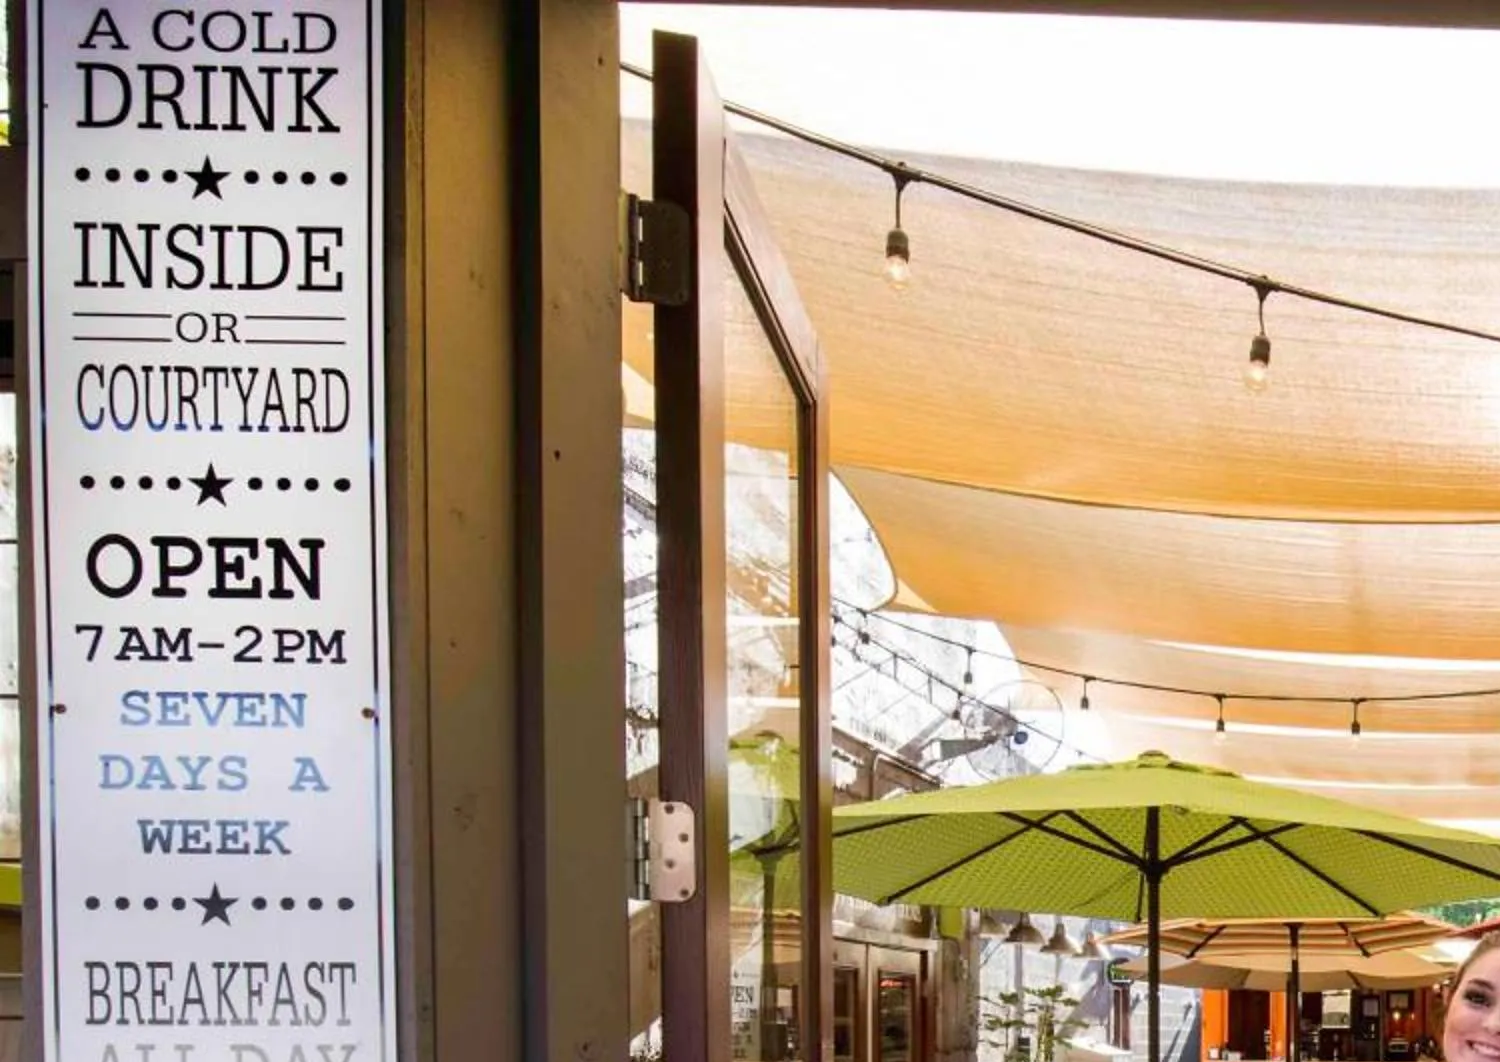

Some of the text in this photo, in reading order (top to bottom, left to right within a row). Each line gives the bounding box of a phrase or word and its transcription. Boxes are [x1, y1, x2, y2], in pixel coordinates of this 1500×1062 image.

[78, 7, 337, 54] A COLD
[74, 60, 341, 133] DRINK
[73, 221, 343, 292] INSIDE
[176, 312, 241, 344] OR
[75, 363, 350, 434] COURTYARD
[86, 533, 326, 600] OPEN
[121, 690, 308, 728] SEVEN
[99, 755, 330, 792] DAYS A
[137, 819, 292, 855] WEEK
[84, 961, 356, 1026] BREAKFAST
